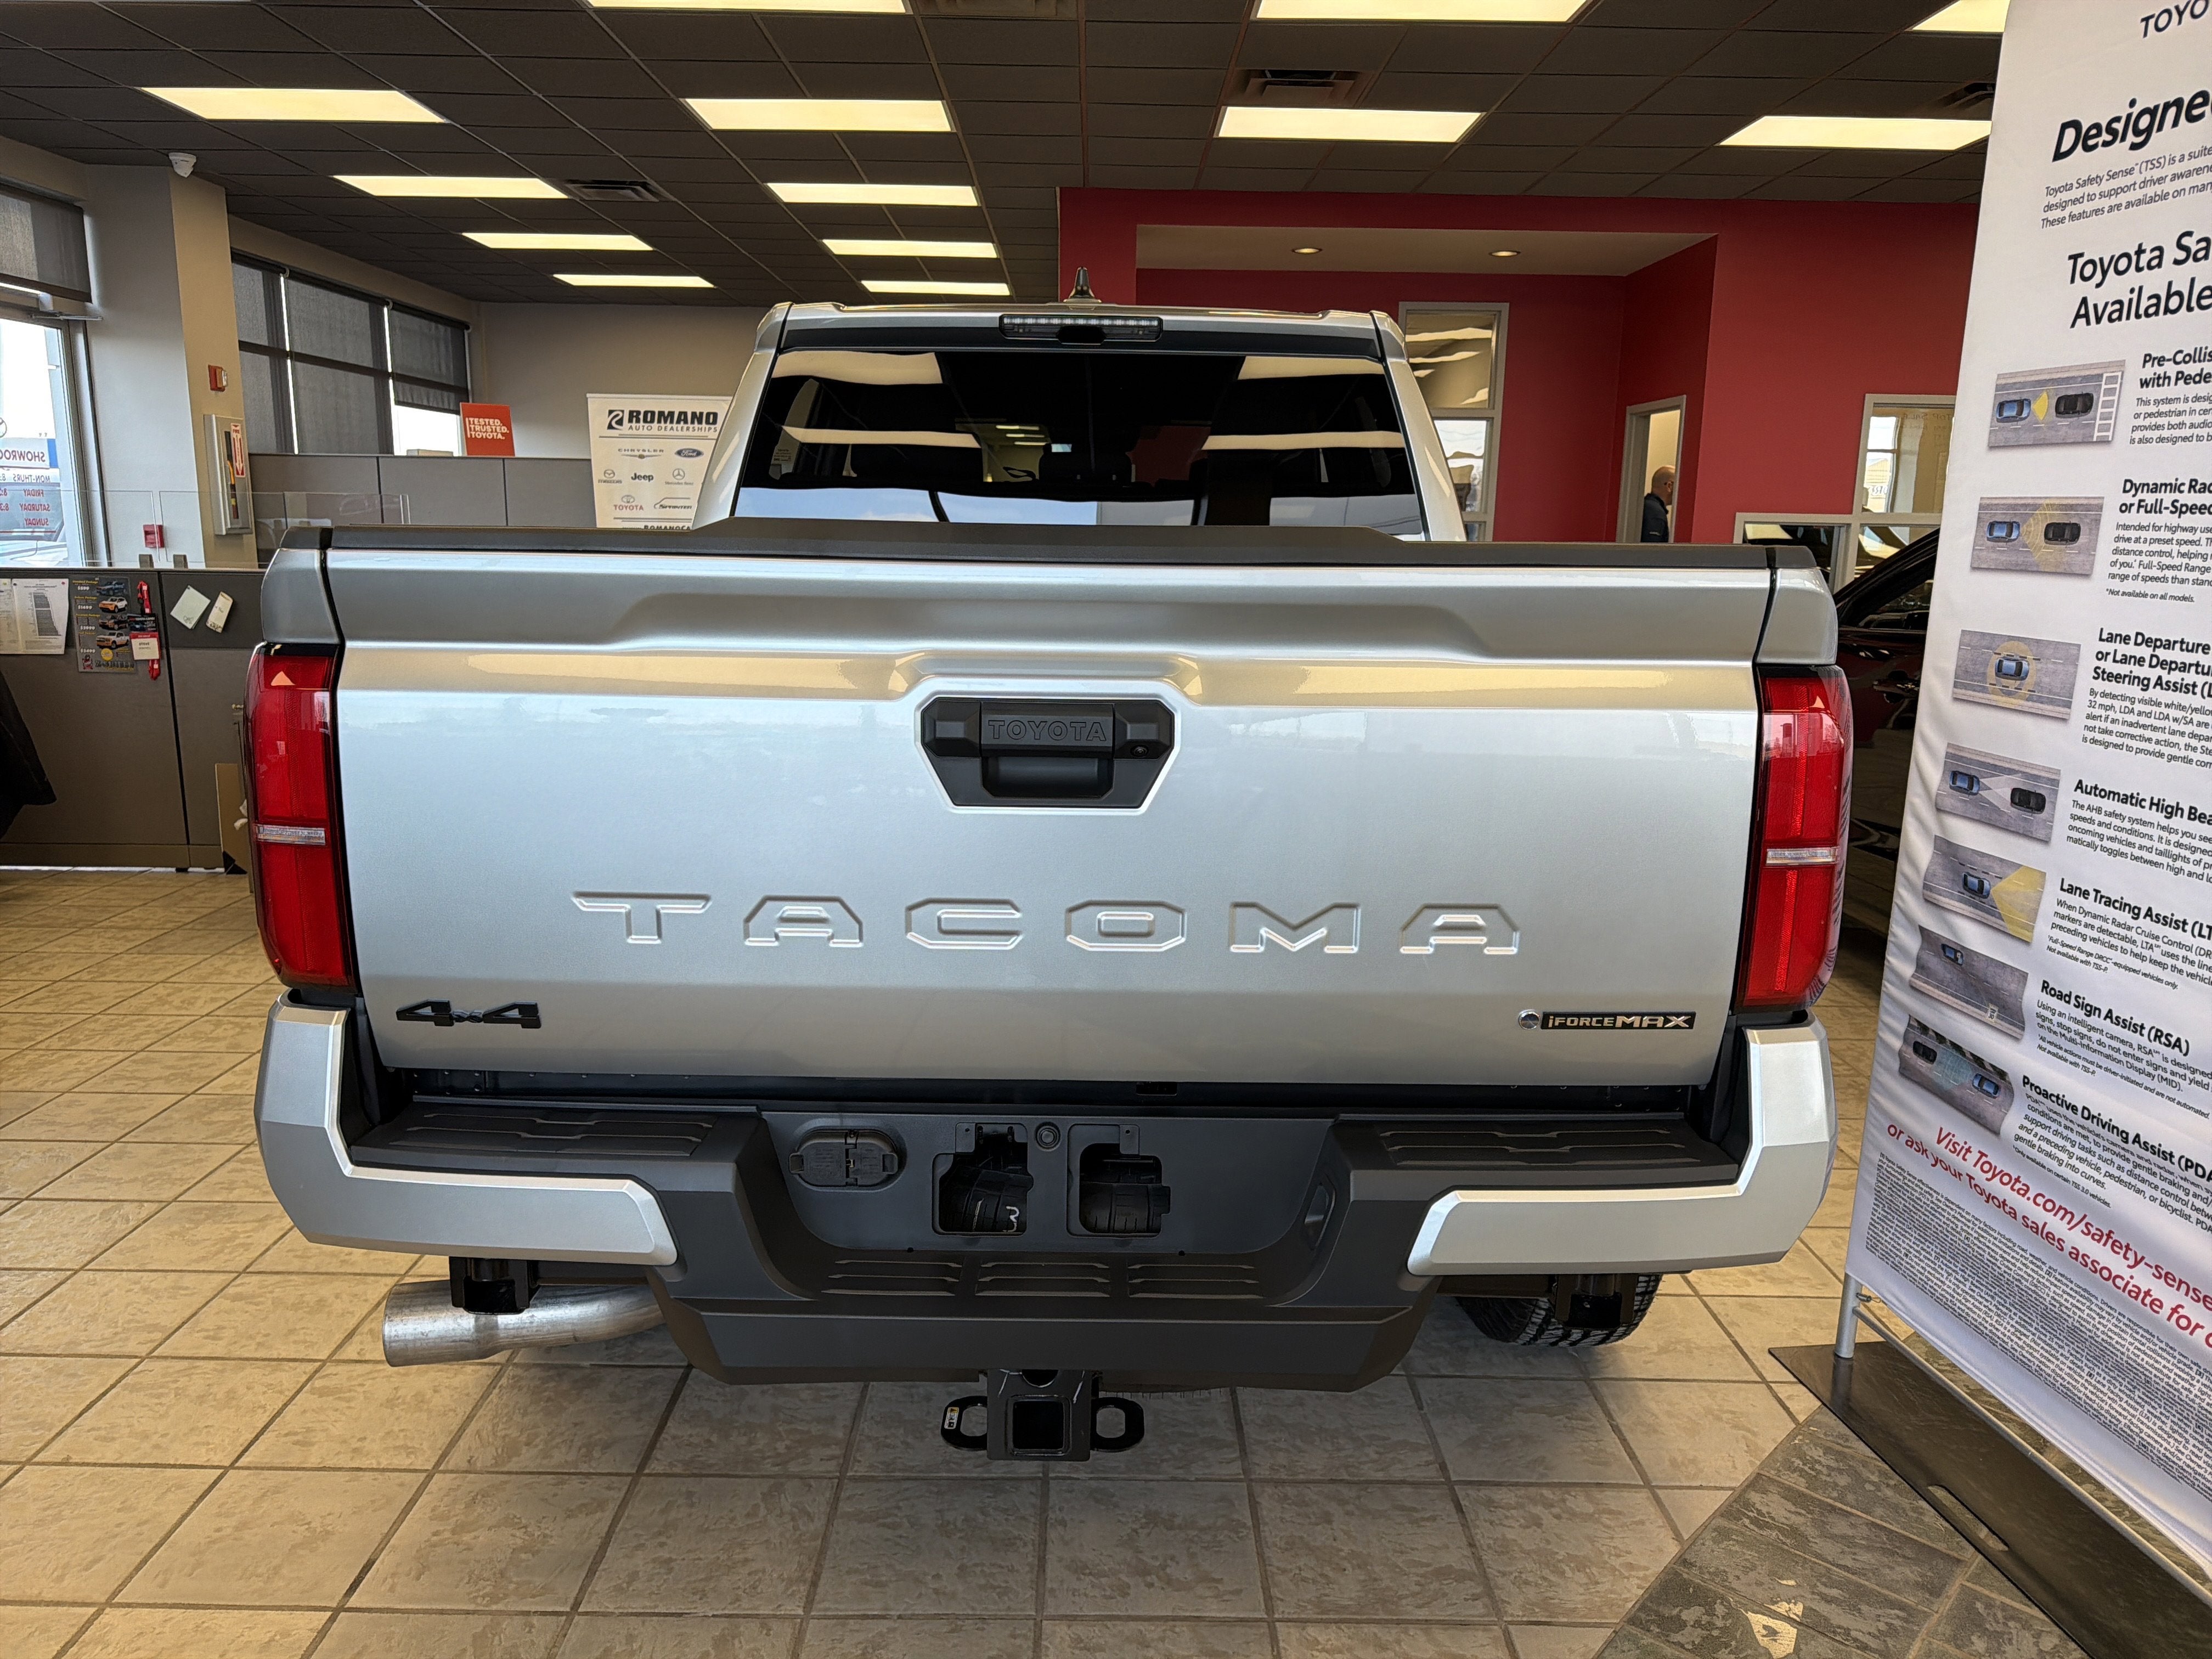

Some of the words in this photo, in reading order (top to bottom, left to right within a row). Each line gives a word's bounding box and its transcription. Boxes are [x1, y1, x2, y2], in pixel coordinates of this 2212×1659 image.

[2052, 89, 2212, 162] Designe
[2045, 182, 2073, 198] Toyota
[2075, 174, 2104, 190] Safety
[2139, 155, 2166, 174] (TSS)
[2168, 153, 2176, 165] is
[2178, 153, 2185, 163] a
[2043, 192, 2085, 213] designed
[2086, 191, 2096, 202] to
[2098, 180, 2137, 200] support
[2139, 174, 2168, 190] driver
[2041, 213, 2066, 229] These
[2068, 204, 2105, 223] features
[2107, 201, 2123, 213] are
[2124, 189, 2170, 209] available
[2171, 189, 2186, 199] on
[2067, 241, 2164, 289] Toyota
[2172, 230, 2211, 266] Sa
[2140, 371, 2171, 389] with
[2174, 367, 2212, 386] Pede
[2134, 411, 2141, 420] or
[2143, 408, 2187, 421] pedestrian
[2188, 407, 2197, 416] in
[2136, 394, 2151, 407] This
[2153, 395, 2181, 408] system
[2182, 394, 2189, 404] is
[469, 417, 503, 426] TESTED.
[470, 425, 509, 433] TRUSTED.
[628, 410, 718, 425] ROMANO
[470, 431, 505, 439] TOYOTA.
[2129, 435, 2136, 445] is
[2137, 435, 2154, 444] also
[2155, 433, 2195, 445] designed
[2196, 433, 2204, 441] to
[631, 473, 654, 482] Jeep
[2122, 477, 2186, 498] Dynamic
[2119, 501, 2135, 514] or
[2114, 534, 2132, 544] drive
[2149, 537, 2174, 547] preset
[2175, 538, 2203, 548] speed.
[2115, 522, 2150, 532] Intended
[2152, 522, 2163, 532] for
[2164, 523, 2198, 535] highway
[2121, 589, 2148, 600] available
[2159, 592, 2168, 600] all
[2169, 593, 2195, 603] models.
[2098, 627, 2131, 646] Lane
[2133, 631, 2211, 655] Departure
[2095, 649, 2111, 662] or
[2112, 648, 2146, 668] Lane
[2092, 665, 2151, 692] Steering
[2152, 674, 2199, 696] Assist
[2087, 699, 2097, 709] 32
[2098, 702, 2118, 714] mph,
[2119, 704, 2135, 716] LDA
[2136, 708, 2152, 719] and
[2153, 710, 2170, 723] LDA
[2172, 715, 2194, 727] w/SA
[2196, 719, 2210, 729] are
[988, 720, 1106, 742] TOYOTA
[2074, 778, 2147, 809] Automatic
[2148, 796, 2185, 820] High
[2072, 799, 2085, 811] The
[2086, 803, 2102, 815] AHB
[2103, 809, 2127, 824] safety
[2128, 815, 2155, 830] system
[2156, 821, 2180, 836] helps
[2181, 829, 2197, 840] you
[2066, 835, 2100, 852] matically
[2100, 843, 2129, 859] toggles
[2130, 851, 2165, 870] between
[2166, 861, 2185, 877] high
[2186, 869, 2205, 881] and
[2059, 877, 2090, 900] Lane
[2092, 888, 2142, 921] Tracing
[2142, 906, 2190, 933] Assist
[572, 892, 1523, 956] TACOMA
[2057, 898, 2077, 913] When
[2078, 906, 2111, 926] Dynamic
[2112, 918, 2135, 933] Radar
[2135, 926, 2161, 942] Cruise
[2162, 935, 2193, 953] Control
[2040, 979, 2073, 1005] Road
[2073, 994, 2102, 1019] Sign
[2103, 1008, 2146, 1037] Assist
[2147, 1025, 2190, 1057] (RSA)
[2035, 1012, 2056, 1026] signs,
[2056, 1018, 2073, 1034] stop
[2073, 1026, 2095, 1045] signs,
[2096, 1037, 2107, 1049] do
[2108, 1043, 2122, 1056] not
[2123, 1049, 2144, 1065] enter
[2146, 1059, 2168, 1076] signs
[2169, 1068, 2187, 1082] and
[2188, 1075, 2210, 1091] yield
[2022, 1074, 2079, 1116] Proactive
[2081, 1105, 2130, 1144] Driving
[2131, 1132, 2176, 1168] Assist
[1934, 1126, 1974, 1164] Visit
[1887, 1122, 1905, 1139] or
[1905, 1131, 1931, 1160] ask
[1931, 1154, 1964, 1183] your
[1965, 1172, 2019, 1222] Toyota
[2021, 1212, 2066, 1253] sales
[2067, 1242, 2165, 1316] associate
[2165, 1302, 2205, 1338] for
